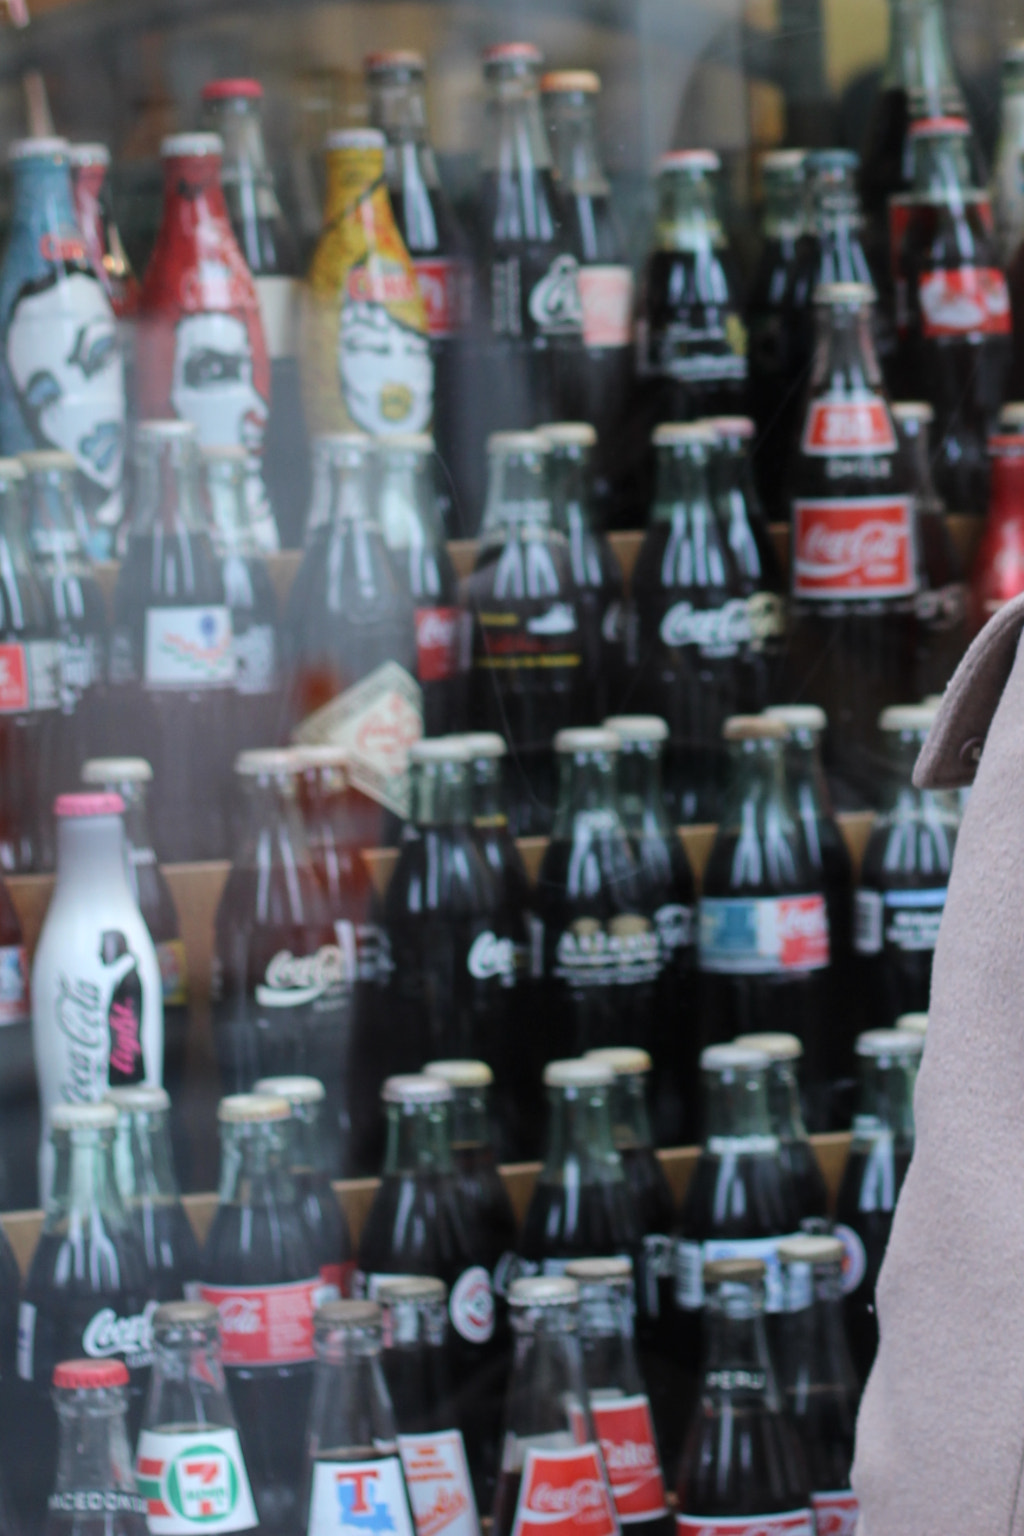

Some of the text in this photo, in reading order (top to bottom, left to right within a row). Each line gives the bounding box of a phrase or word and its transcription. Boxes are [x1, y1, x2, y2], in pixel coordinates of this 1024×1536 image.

[806, 521, 908, 563] Coca-Cola
[706, 1370, 765, 1391] PERU
[336, 1469, 380, 1513] T
[530, 1477, 608, 1514] Coca-Cola
